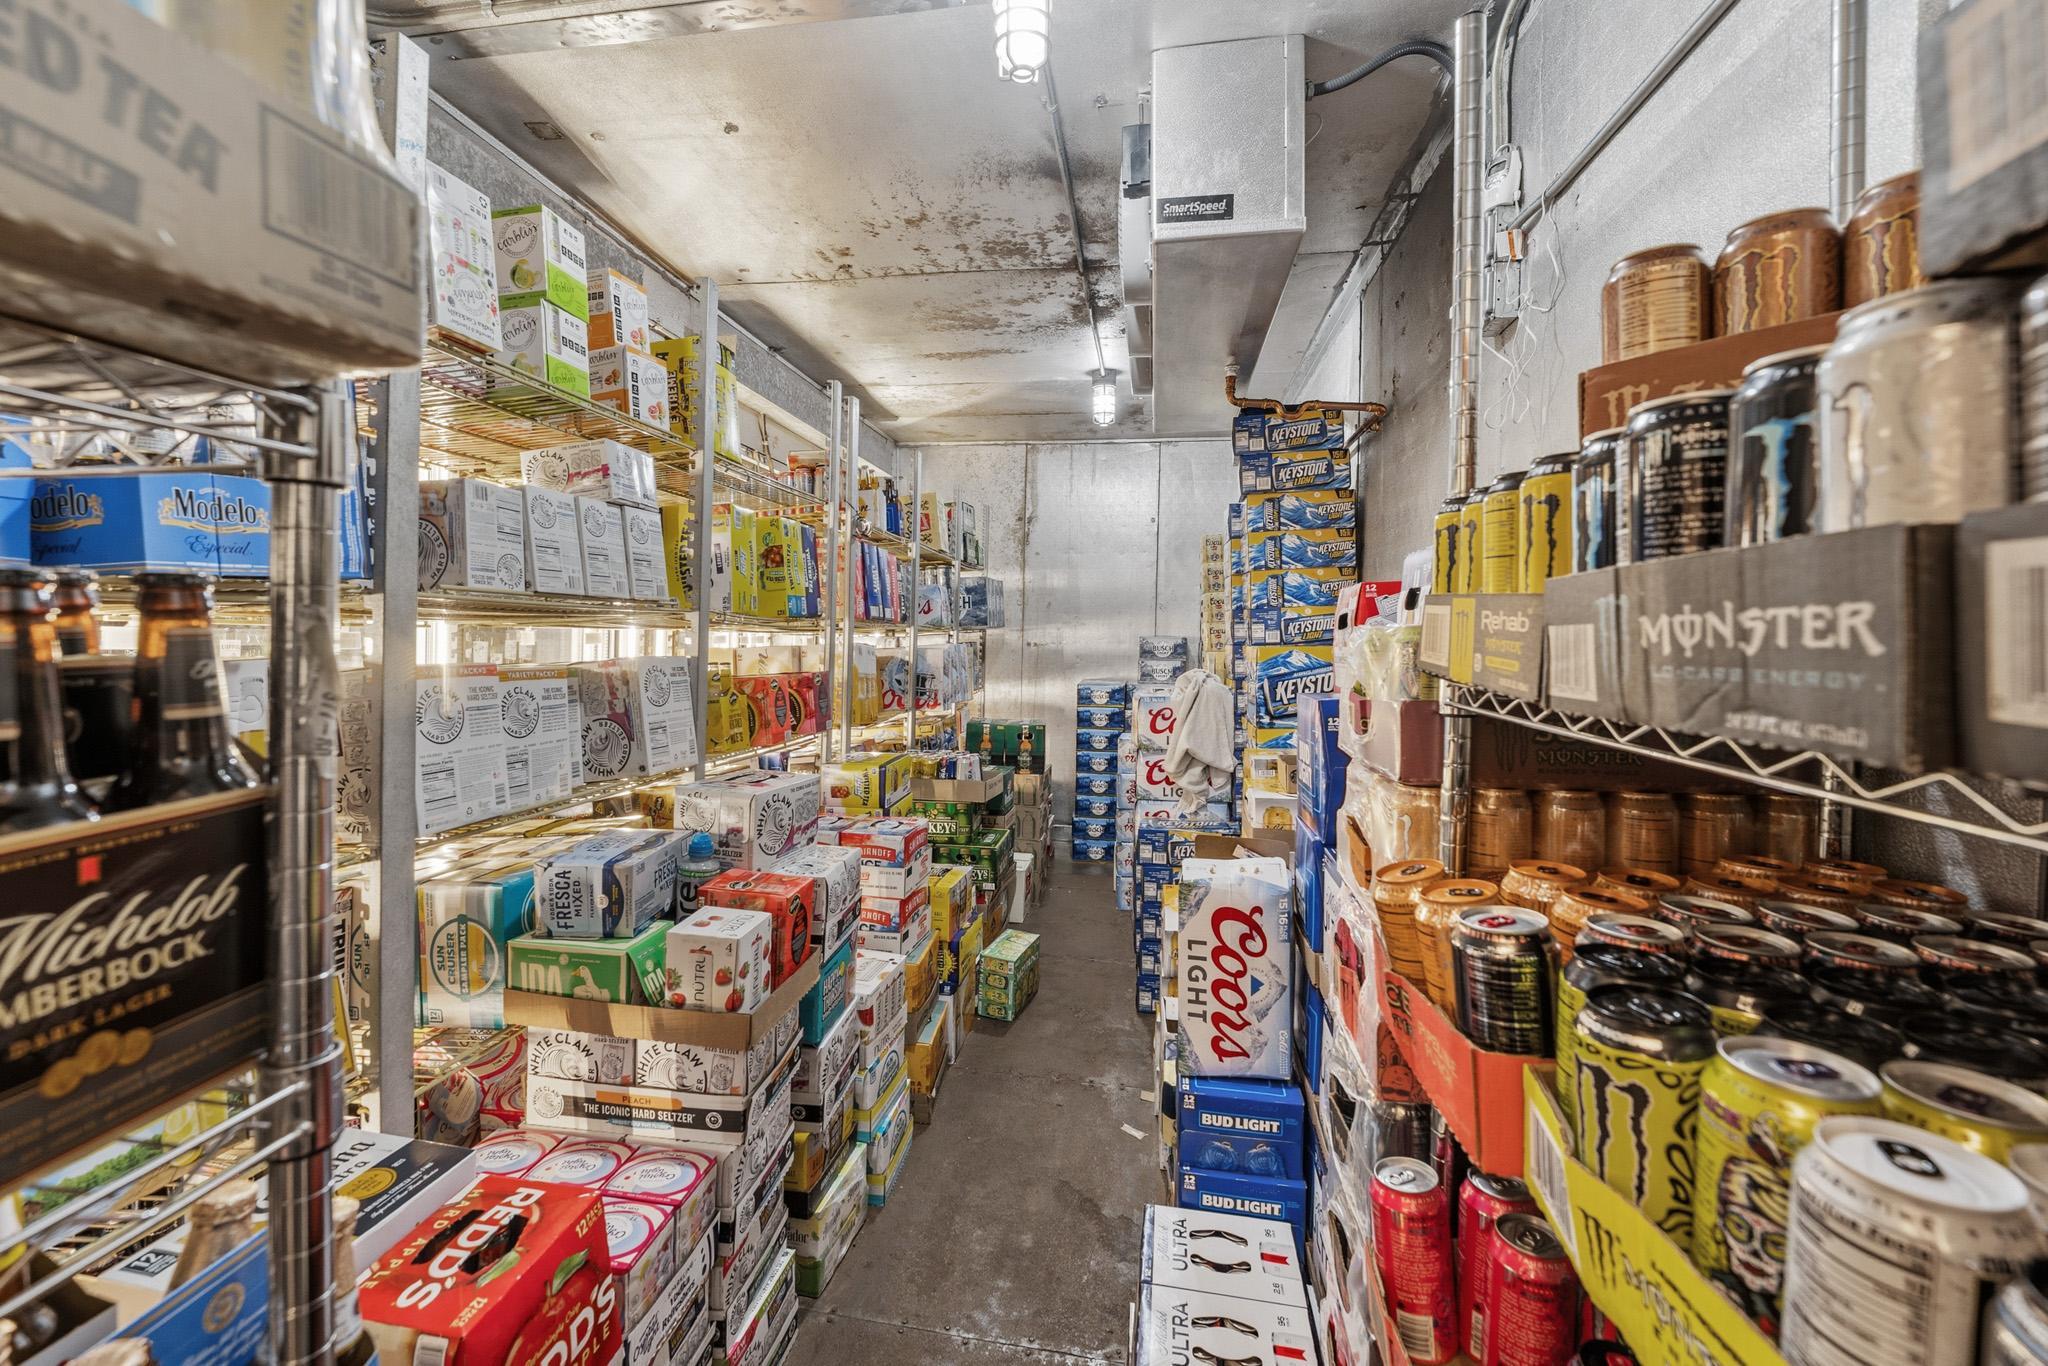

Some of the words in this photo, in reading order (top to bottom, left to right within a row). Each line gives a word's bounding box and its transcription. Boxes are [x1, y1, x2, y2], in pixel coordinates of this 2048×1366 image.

[98, 54, 230, 195] TEA
[1163, 199, 1226, 214] SmartSpeed
[497, 225, 538, 251] carbliss
[502, 319, 537, 342] arbliss
[589, 353, 617, 366] arbliss
[1272, 421, 1322, 443] KEYSTONE
[1287, 435, 1308, 446] LIGHT
[540, 450, 566, 464] CLAW
[1278, 461, 1329, 483] KEYSTONE
[1294, 475, 1316, 486] LIGHT
[31, 485, 89, 520] odelo
[172, 486, 258, 525] Modelo
[1317, 501, 1353, 516] KEYSTONE
[184, 533, 254, 557] Especial
[418, 521, 444, 549] SELTZE
[1481, 610, 1530, 633] Rehab
[1639, 601, 1887, 657] MONSTER
[1302, 630, 1324, 640] LIGHT
[513, 686, 537, 702] CLAW
[1275, 672, 1334, 705] KEYSTO
[415, 689, 433, 726] WHITE
[432, 685, 460, 703] CLW
[583, 759, 616, 778] WHITE
[1162, 787, 1184, 798] LIG
[756, 800, 772, 840] WHITE
[771, 793, 792, 809] CLAW
[928, 821, 957, 834] KEYS
[861, 847, 892, 858] IRNOFF
[1174, 845, 1196, 859] KEYS
[554, 868, 575, 931] FRESCA
[572, 880, 585, 918] MIXED
[1278, 898, 1288, 912] 15
[858, 923, 876, 932] CE
[860, 910, 887, 923] RNOFF
[1278, 912, 1288, 925] 16
[460, 922, 468, 949] PACK
[353, 943, 363, 970] SUN
[436, 944, 446, 971] SUN
[447, 931, 457, 985] CRUISER
[725, 942, 733, 954] 4
[460, 949, 469, 996] SAMPLER
[1187, 938, 1208, 1024] LIGHT
[1210, 905, 1268, 1064] Coors
[529, 1037, 553, 1077] WHITE
[554, 1032, 595, 1059] CLAW
[637, 1045, 661, 1087] WHITE
[663, 1042, 704, 1069] CLAW
[621, 1095, 652, 1106] PEACH
[1183, 1094, 1195, 1102] 12
[583, 1102, 600, 1115] THE
[601, 1103, 631, 1118] ICONIC
[631, 1106, 656, 1120] HARD
[657, 1109, 694, 1124] SELTZER
[1201, 1112, 1234, 1128] BUD
[1235, 1116, 1281, 1133] LIGHT
[1183, 1174, 1196, 1183] 12
[433, 1188, 485, 1230] HARD
[1201, 1194, 1235, 1210] BUD
[1236, 1199, 1282, 1217] LIGHT
[575, 1220, 590, 1239] 12
[395, 1186, 546, 1310] REDD'S
[1172, 1217, 1189, 1272] ULTRA
[130, 1250, 164, 1271] 12
[360, 1237, 427, 1290] APPLE
[472, 1296, 488, 1311] 12
[1277, 1315, 1286, 1327] 95
[1172, 1302, 1190, 1366] ULTRA
